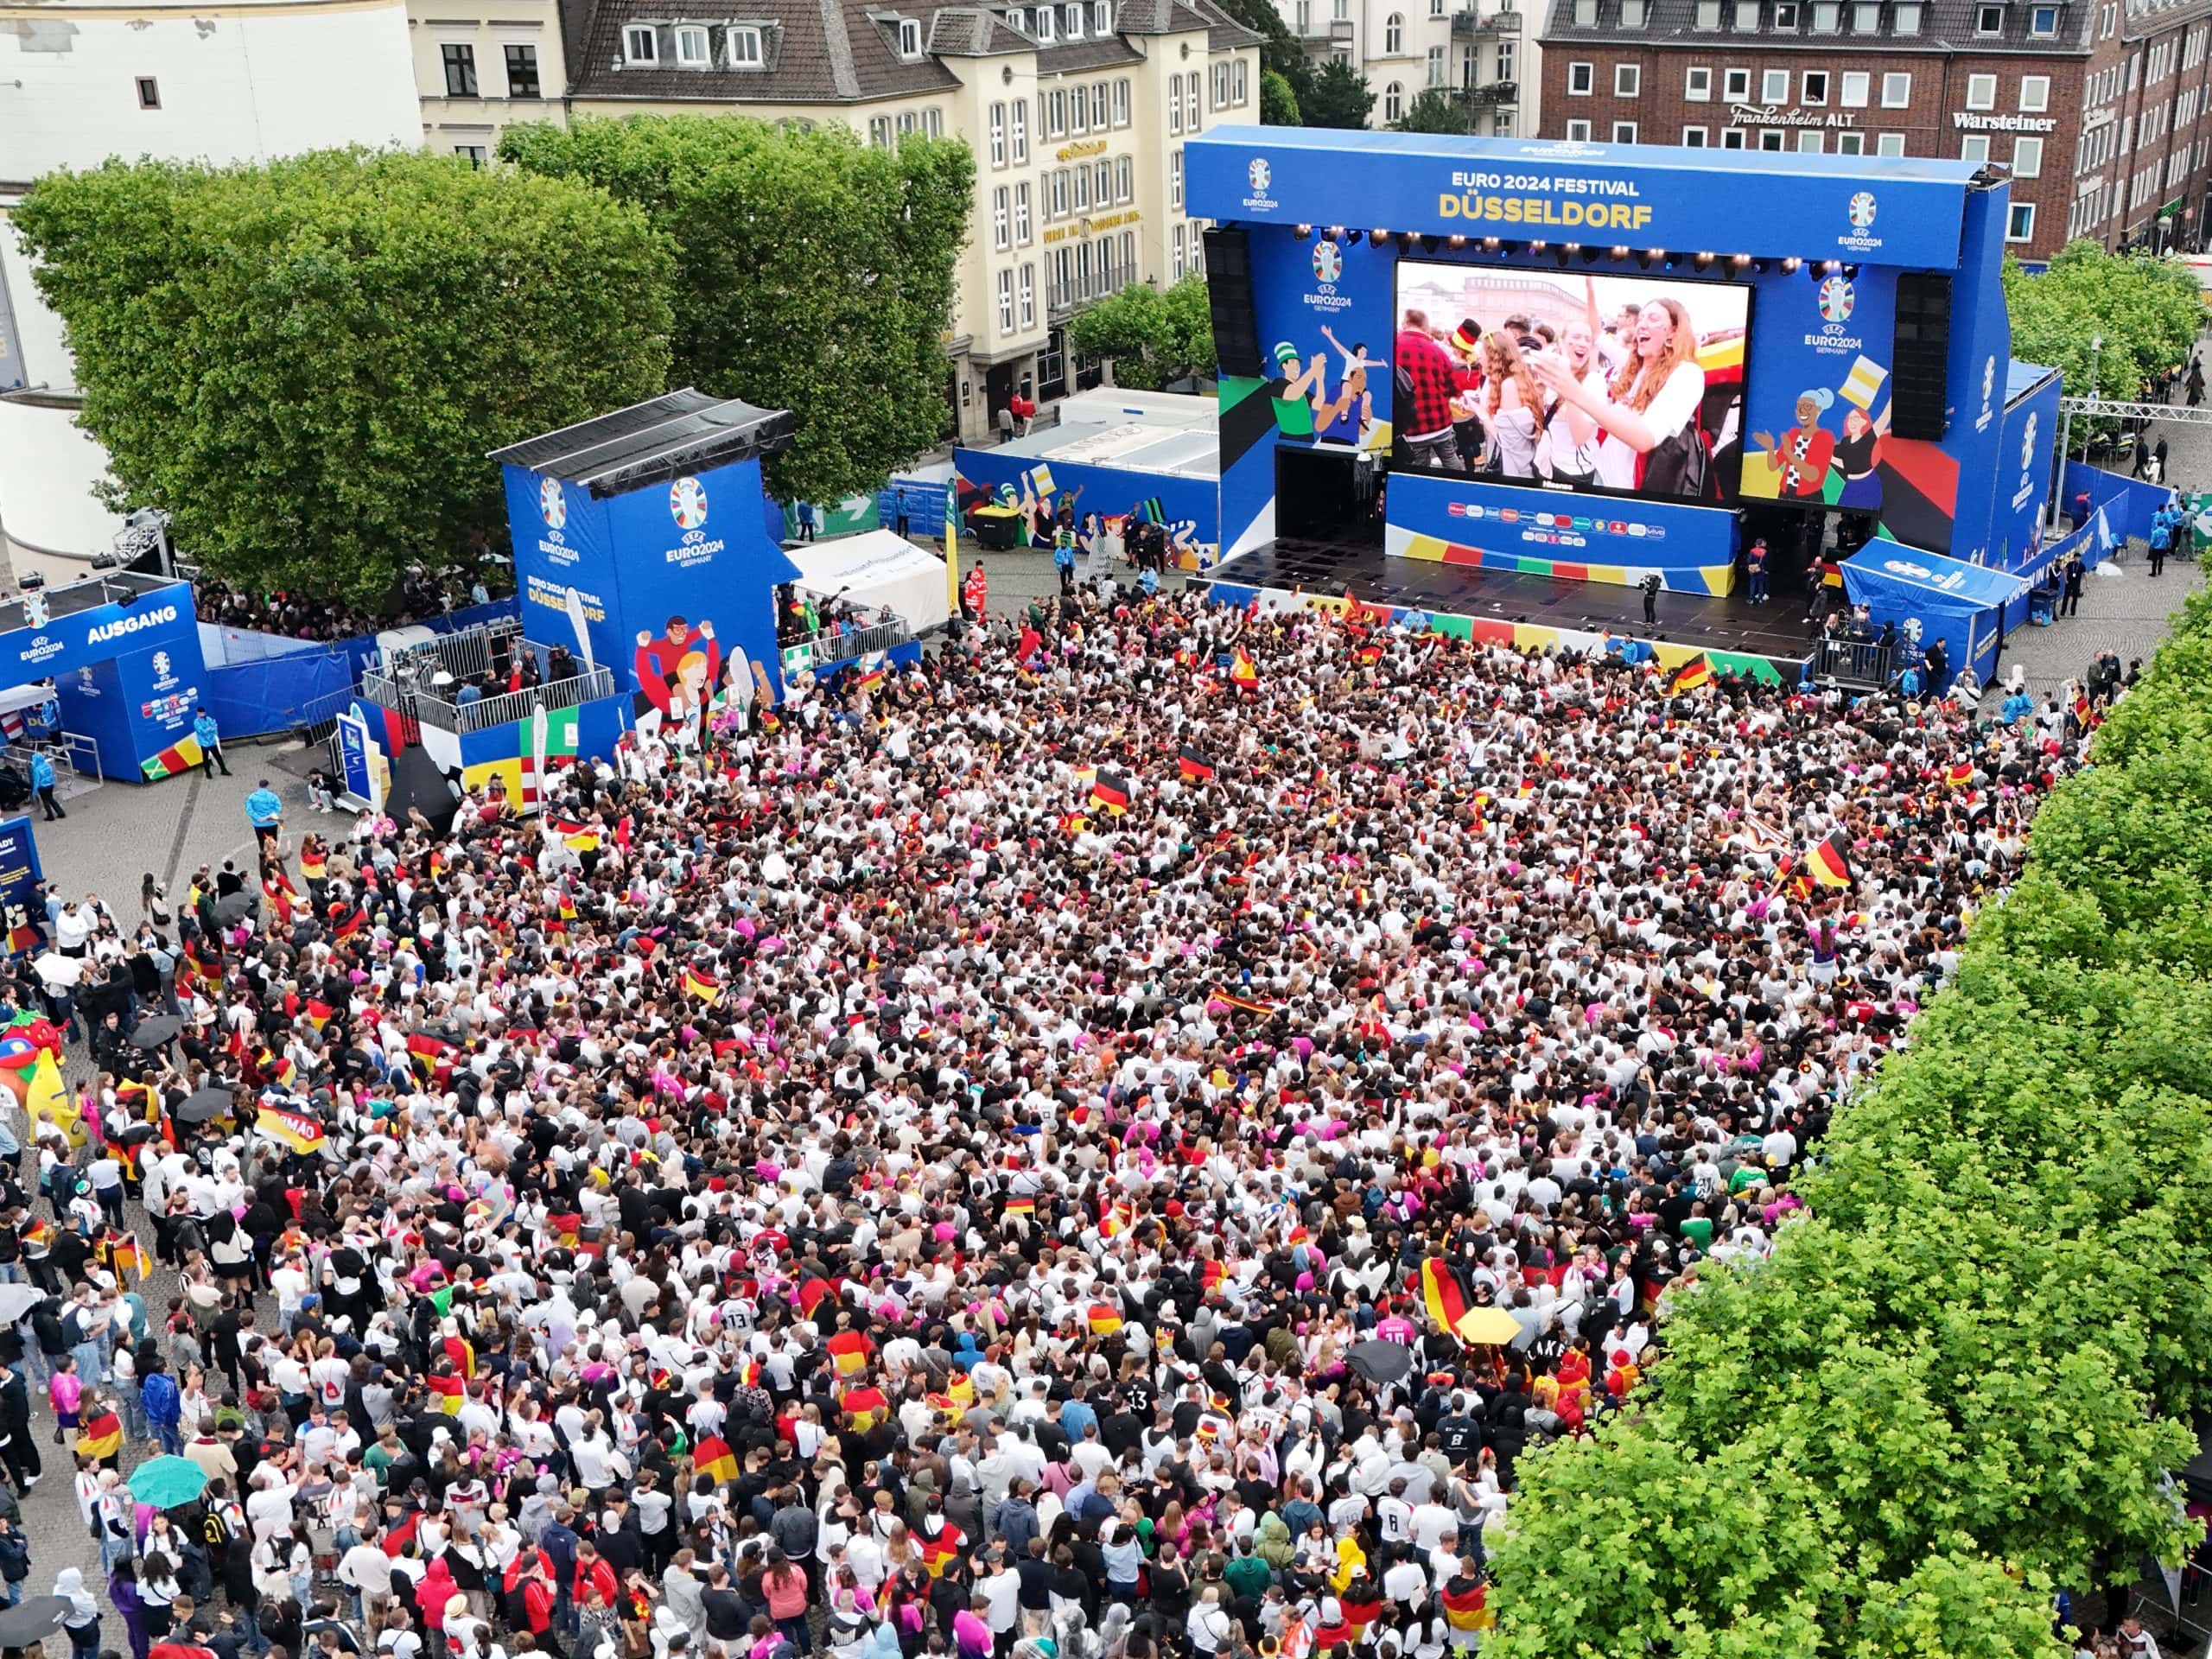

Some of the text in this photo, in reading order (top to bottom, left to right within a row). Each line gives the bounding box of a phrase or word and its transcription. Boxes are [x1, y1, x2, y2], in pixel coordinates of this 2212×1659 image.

[1730, 103, 1855, 127] Frankenheim ALT
[1953, 112, 2056, 131] Warsteiner
[1452, 171, 1640, 196] EURO 2024 FESTIVAL
[1440, 188, 1652, 230] DÜSSELDORF
[1838, 236, 1882, 247] EURO2024
[1303, 294, 1351, 307] EURO2024
[1821, 323, 1846, 337] UEFA
[1804, 334, 1862, 349] EURO2024
[1816, 346, 1848, 354] GERMANY
[681, 530, 706, 546] UEFA
[538, 539, 580, 563] EURO2024
[665, 538, 725, 563] EURO2024
[680, 555, 712, 568] GERMANY
[527, 575, 547, 589] EURO
[547, 582, 566, 595] 2024
[87, 605, 177, 645] AUSGANG
[20, 640, 64, 661] EURO2024
[728, 1313, 747, 1328] 13
[1127, 1390, 1147, 1410] 13
[1451, 1434, 1464, 1446] 8
[312, 1500, 327, 1516] 10
[1388, 1514, 1398, 1533] 8
